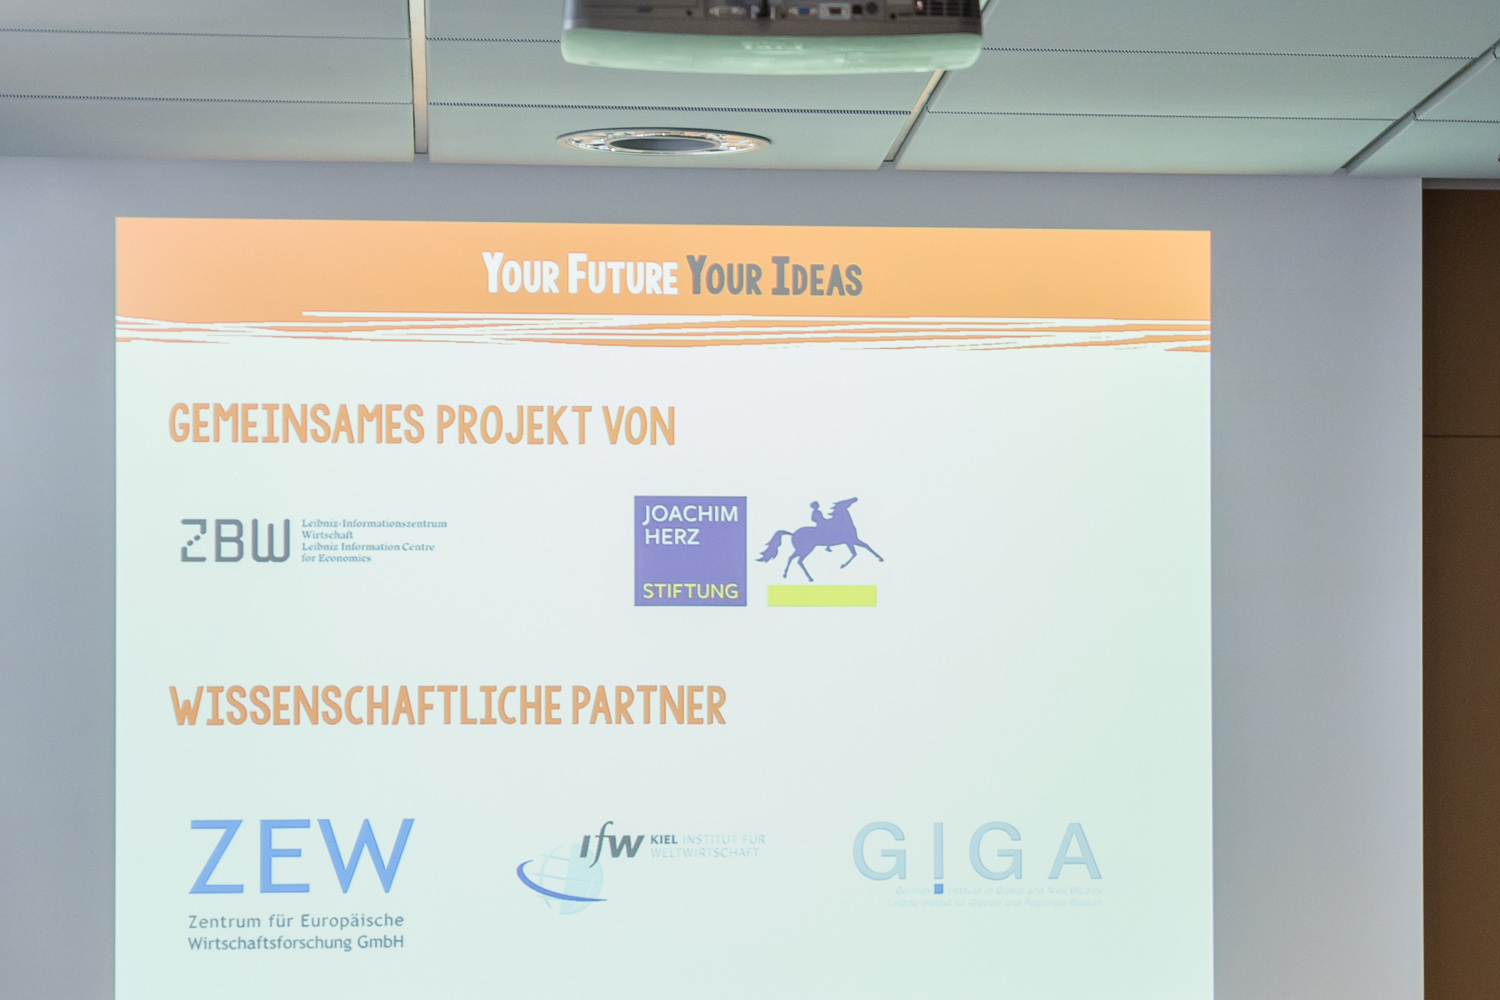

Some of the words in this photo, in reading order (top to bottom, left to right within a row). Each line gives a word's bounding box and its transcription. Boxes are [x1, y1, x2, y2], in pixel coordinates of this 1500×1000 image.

[168, 402, 425, 444] GEMEINSAMES
[437, 404, 592, 445] PROJEKT
[602, 405, 676, 446] VON
[642, 504, 739, 523] JOACHIM
[302, 519, 447, 529] Leibniz-Informationszentrum
[181, 518, 290, 564] ZBW
[302, 530, 353, 541] Wirtschaft
[645, 527, 700, 547] HERZ
[302, 542, 338, 552] Leibniz
[341, 542, 400, 552] Information
[402, 542, 435, 552] Centre
[302, 553, 316, 563] for
[318, 553, 371, 564] Economics
[642, 582, 739, 601] STIFTUNG
[169, 685, 562, 727] WISSENSCHAFTLICHE
[572, 685, 726, 727] PARTNER
[651, 835, 678, 844] KIEL
[683, 834, 738, 844] INSTITUT
[188, 818, 415, 895] ZEW
[188, 915, 261, 928] Zentrum
[269, 914, 294, 928] für
[301, 913, 405, 930] Europäische
[188, 936, 352, 952] Wirtschaftsforschung
[357, 935, 404, 949] GmbH
